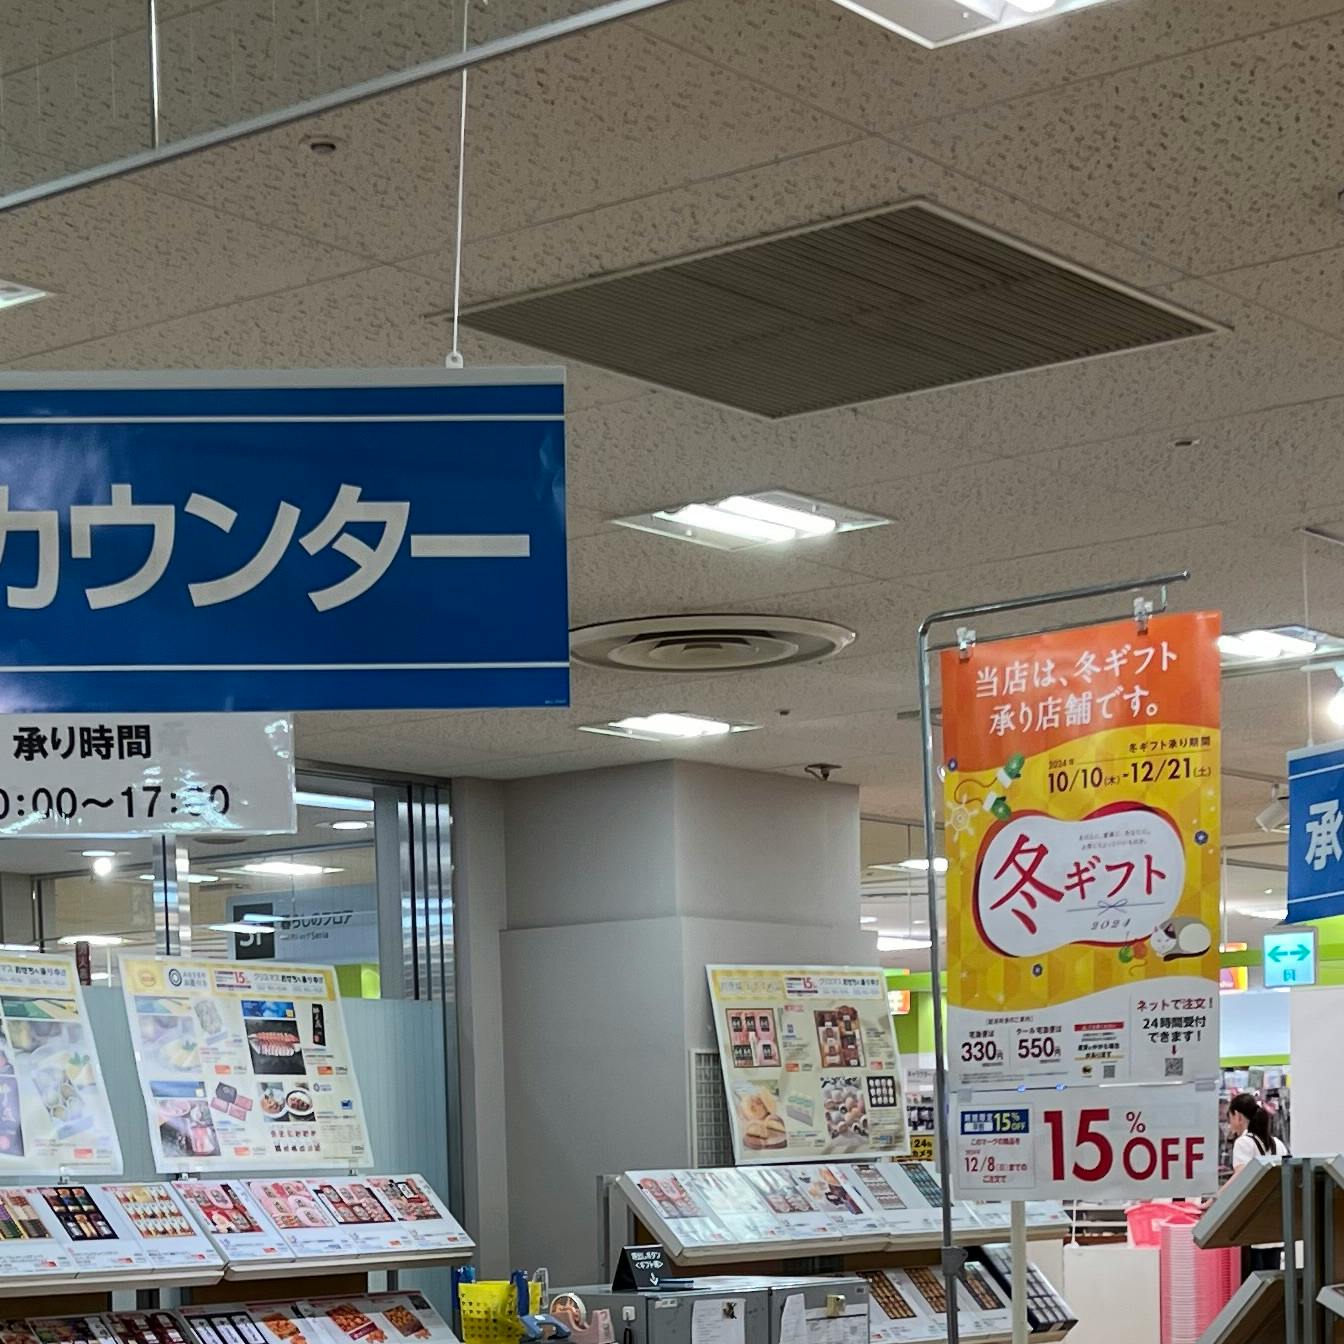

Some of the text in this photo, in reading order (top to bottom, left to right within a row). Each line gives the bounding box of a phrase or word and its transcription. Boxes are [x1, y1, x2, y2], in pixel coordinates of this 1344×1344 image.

[975, 640, 1178, 699] 当店は、冬ギフト
[989, 686, 1158, 737] 承り店舗です。
[12, 724, 152, 762] 承り時間
[1128, 735, 1211, 752] 冬ギフト承り期間
[989, 833, 1168, 936] 冬ギフト
[1090, 917, 1133, 932] 2024
[1136, 997, 1214, 1012] ネットで注文！
[1142, 1015, 1207, 1030] 24時間受付
[1043, 1107, 1206, 1182] 15 % OFF
